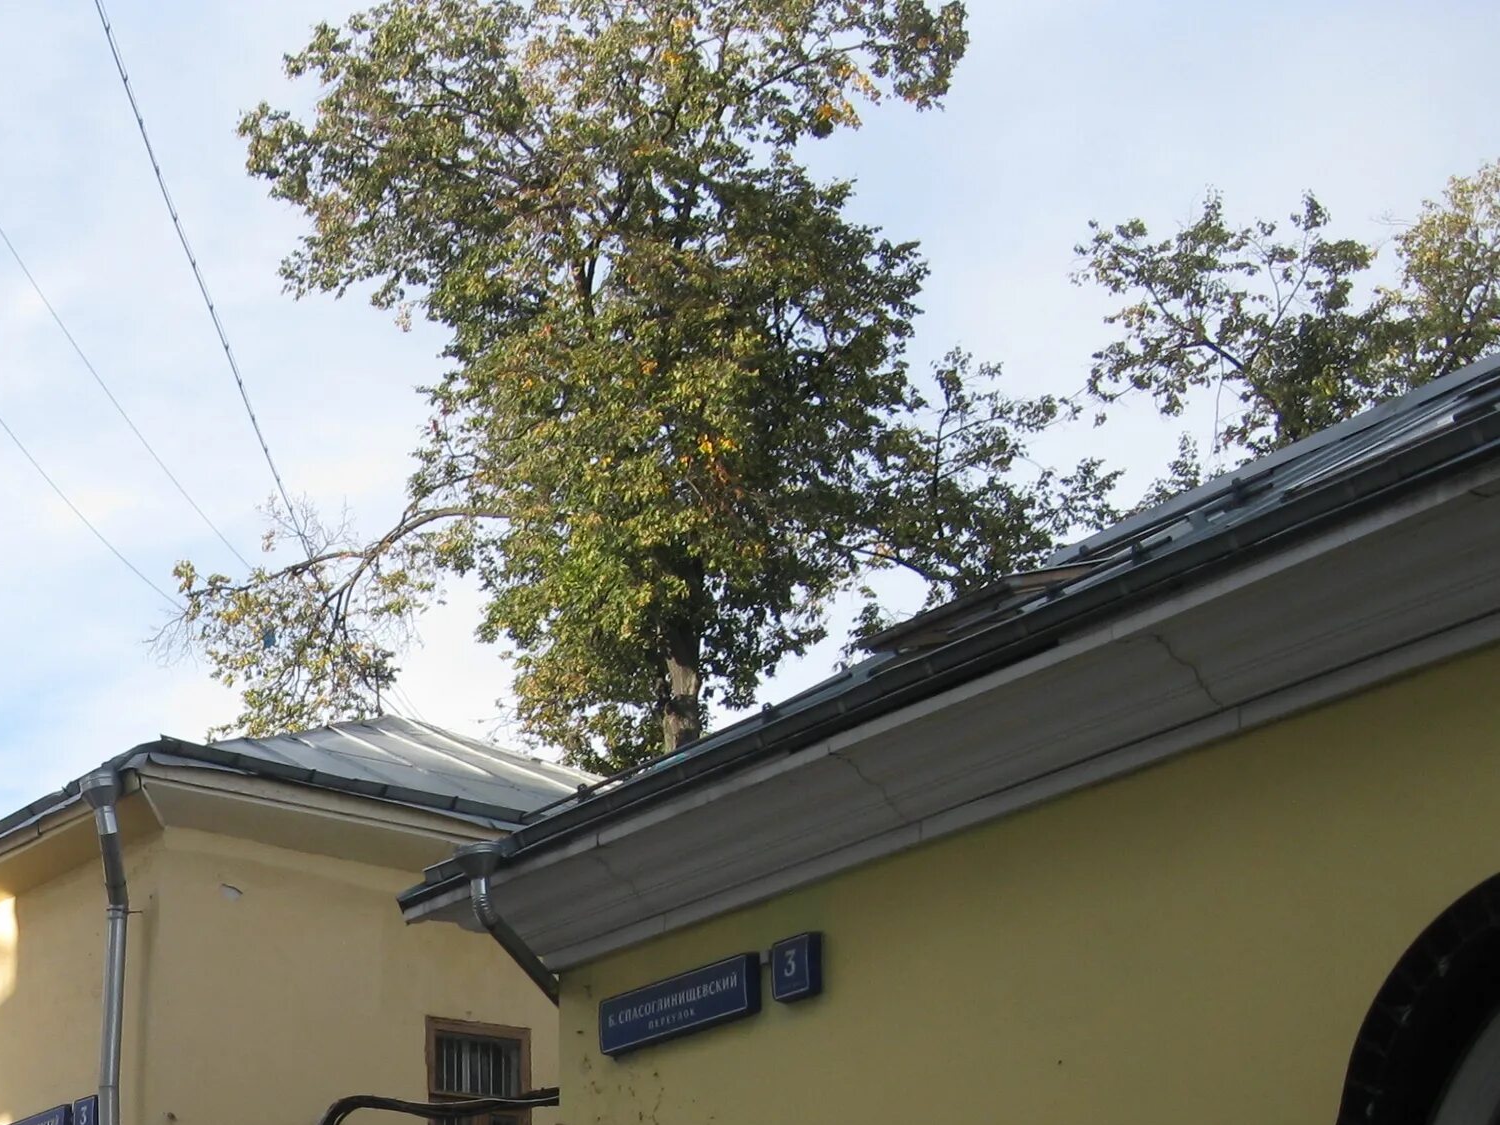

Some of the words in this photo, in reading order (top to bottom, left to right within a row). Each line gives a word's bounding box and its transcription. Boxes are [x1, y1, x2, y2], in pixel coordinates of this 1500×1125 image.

[784, 949, 796, 977] 3
[618, 971, 739, 1025] СПАСОГЛИНИЩЕВСКИЙ
[647, 1008, 698, 1030] ПЕРЕУЛОК
[80, 1106, 88, 1125] 3
